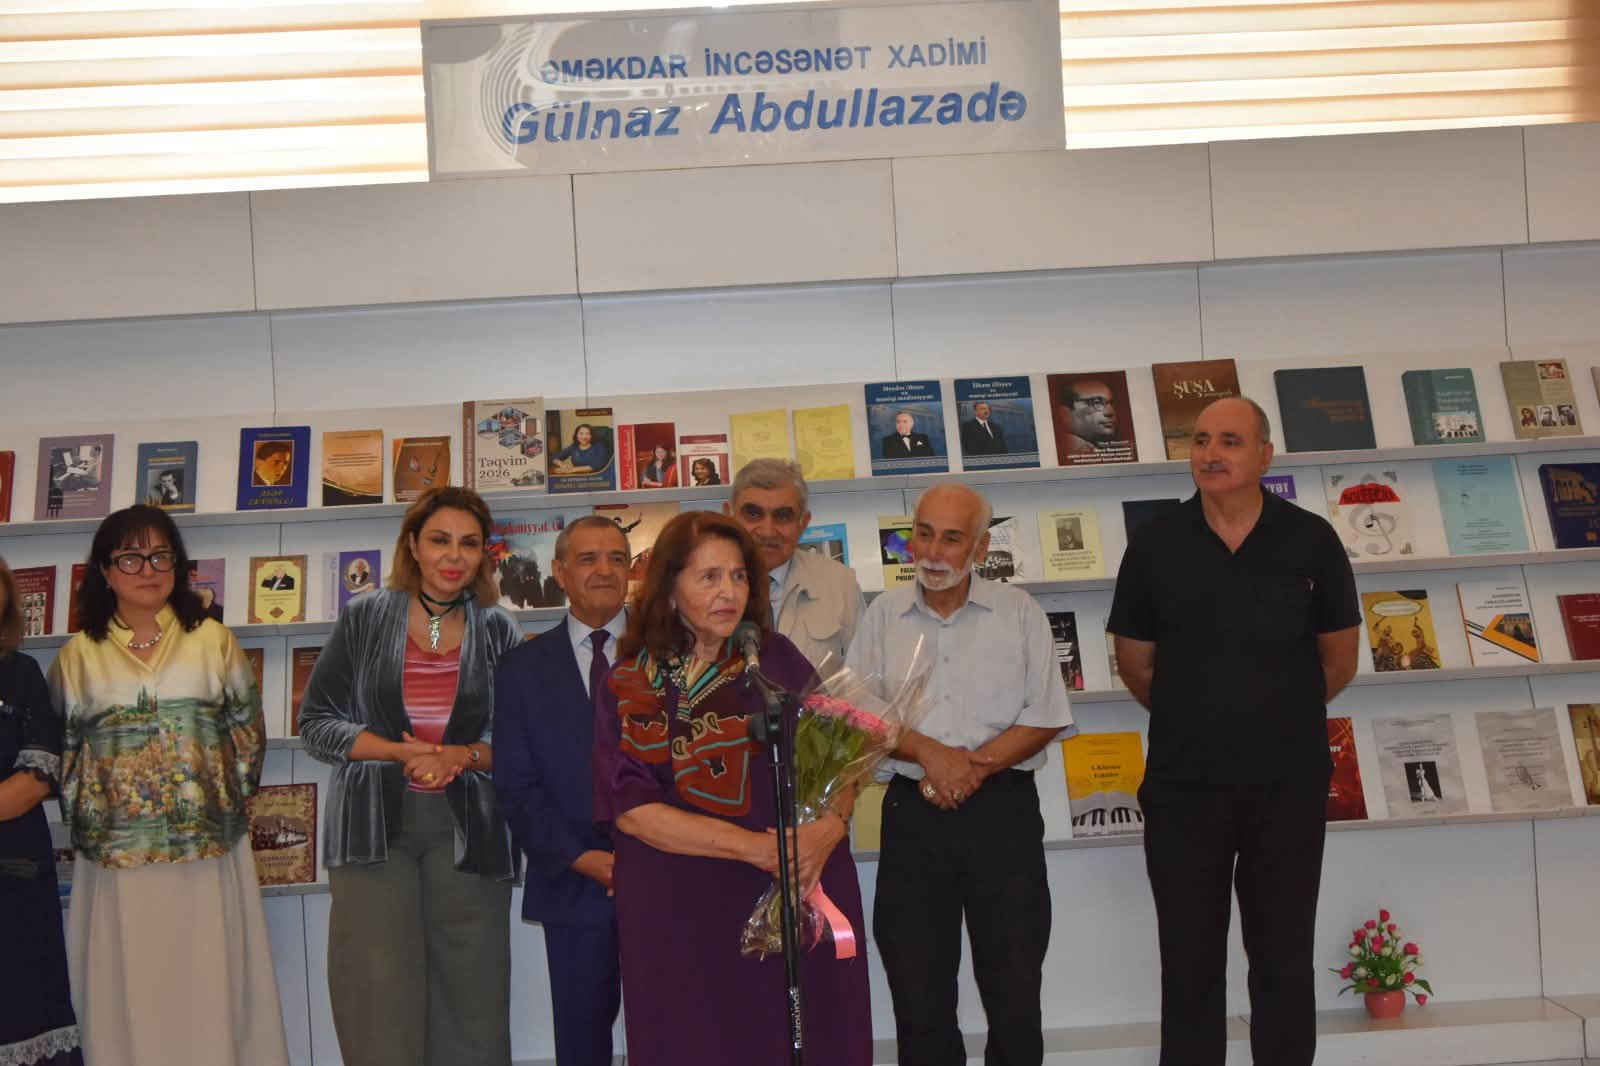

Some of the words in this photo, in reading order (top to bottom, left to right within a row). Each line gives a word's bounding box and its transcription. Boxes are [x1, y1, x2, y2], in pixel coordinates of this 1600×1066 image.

[540, 55, 688, 84] ƏMƏKDAR
[704, 46, 871, 77] İNCƏSƏNƏT
[888, 36, 986, 69] XADİMİ
[502, 101, 681, 144] Gülnaz
[709, 82, 1027, 134] Abdullazadə
[479, 456, 527, 472] Təqvim
[480, 469, 511, 479] 2026
